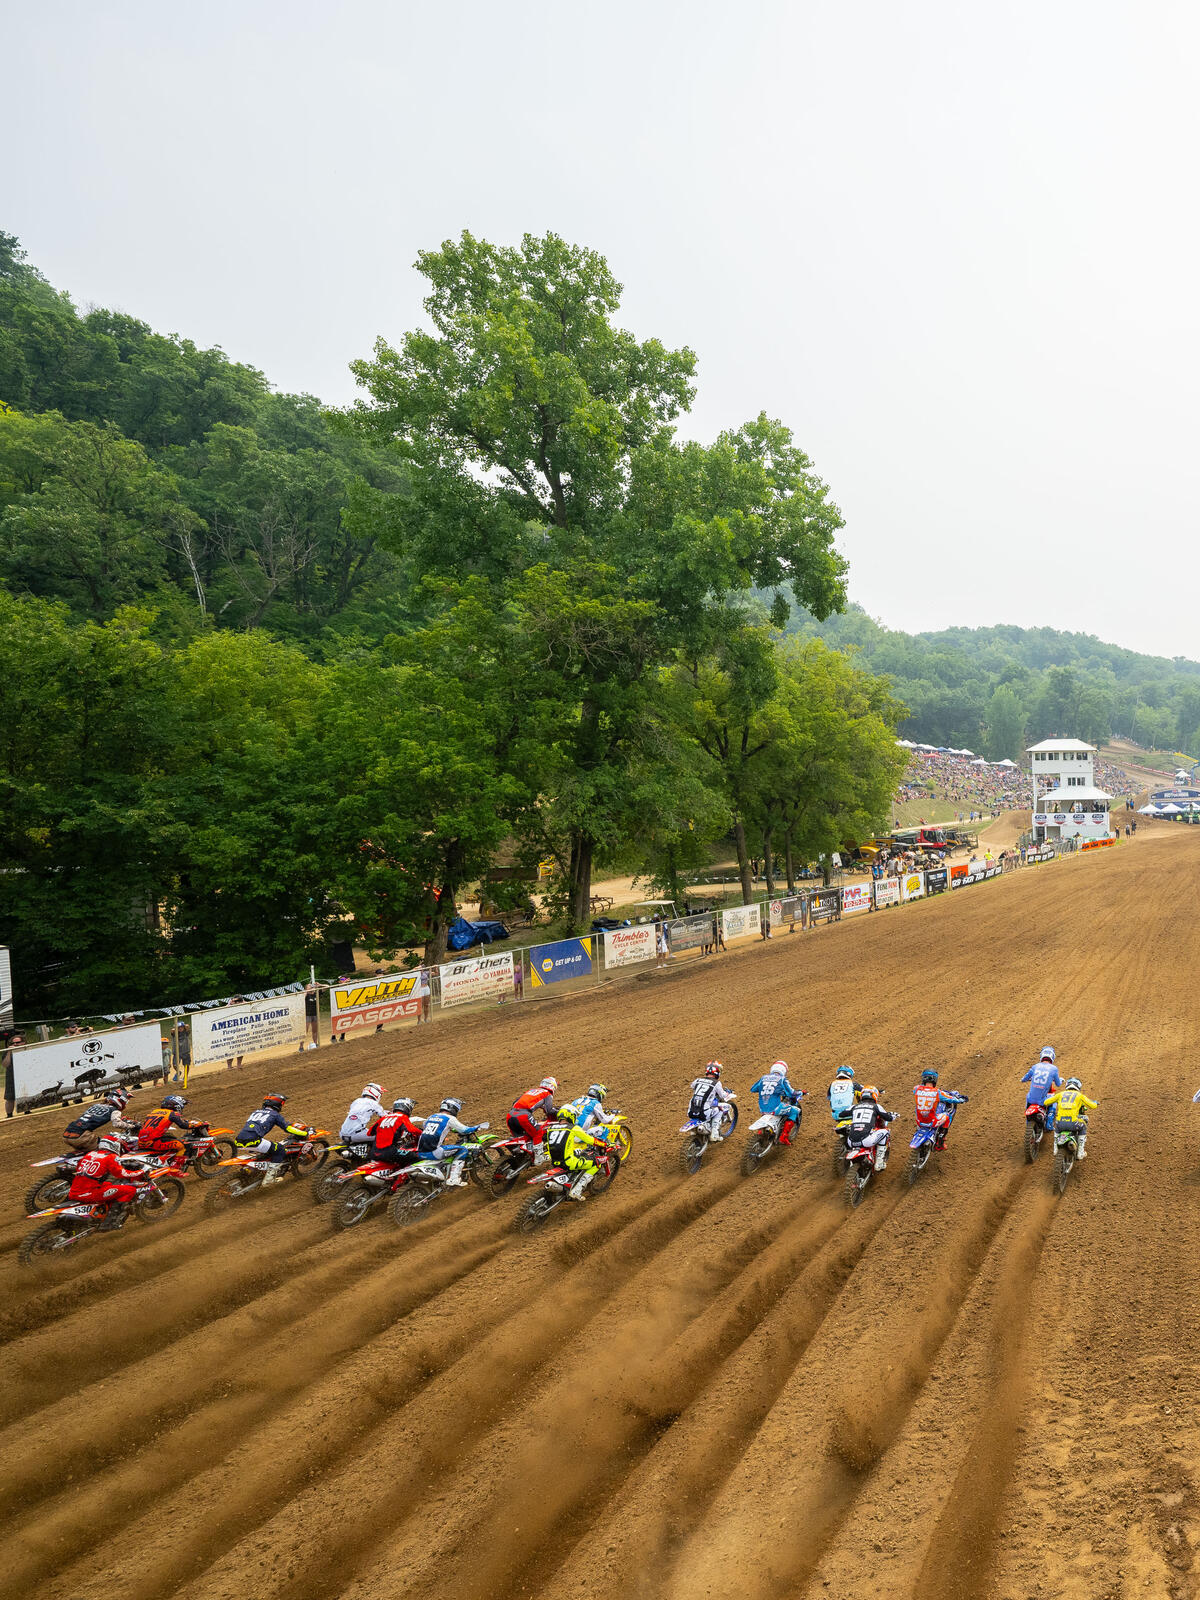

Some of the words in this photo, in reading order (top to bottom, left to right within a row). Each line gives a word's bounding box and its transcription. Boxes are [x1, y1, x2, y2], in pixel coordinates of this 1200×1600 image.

[612, 930, 650, 945] Trimble's
[630, 938, 648, 947] CENTER
[442, 955, 511, 977] 2Brthers
[555, 959, 565, 967] GET
[565, 957, 571, 965] UP
[490, 967, 512, 978] YAMAHA
[453, 977, 480, 987] HONDA
[335, 977, 418, 1010] VAITH
[211, 1013, 261, 1032] AMERICAN
[262, 1007, 290, 1020] HOME
[336, 1001, 418, 1031] GASGAS
[69, 1053, 115, 1069] ICON
[1033, 1069, 1050, 1084] 23
[695, 1083, 711, 1097] 12
[74, 1205, 92, 1215] 530
